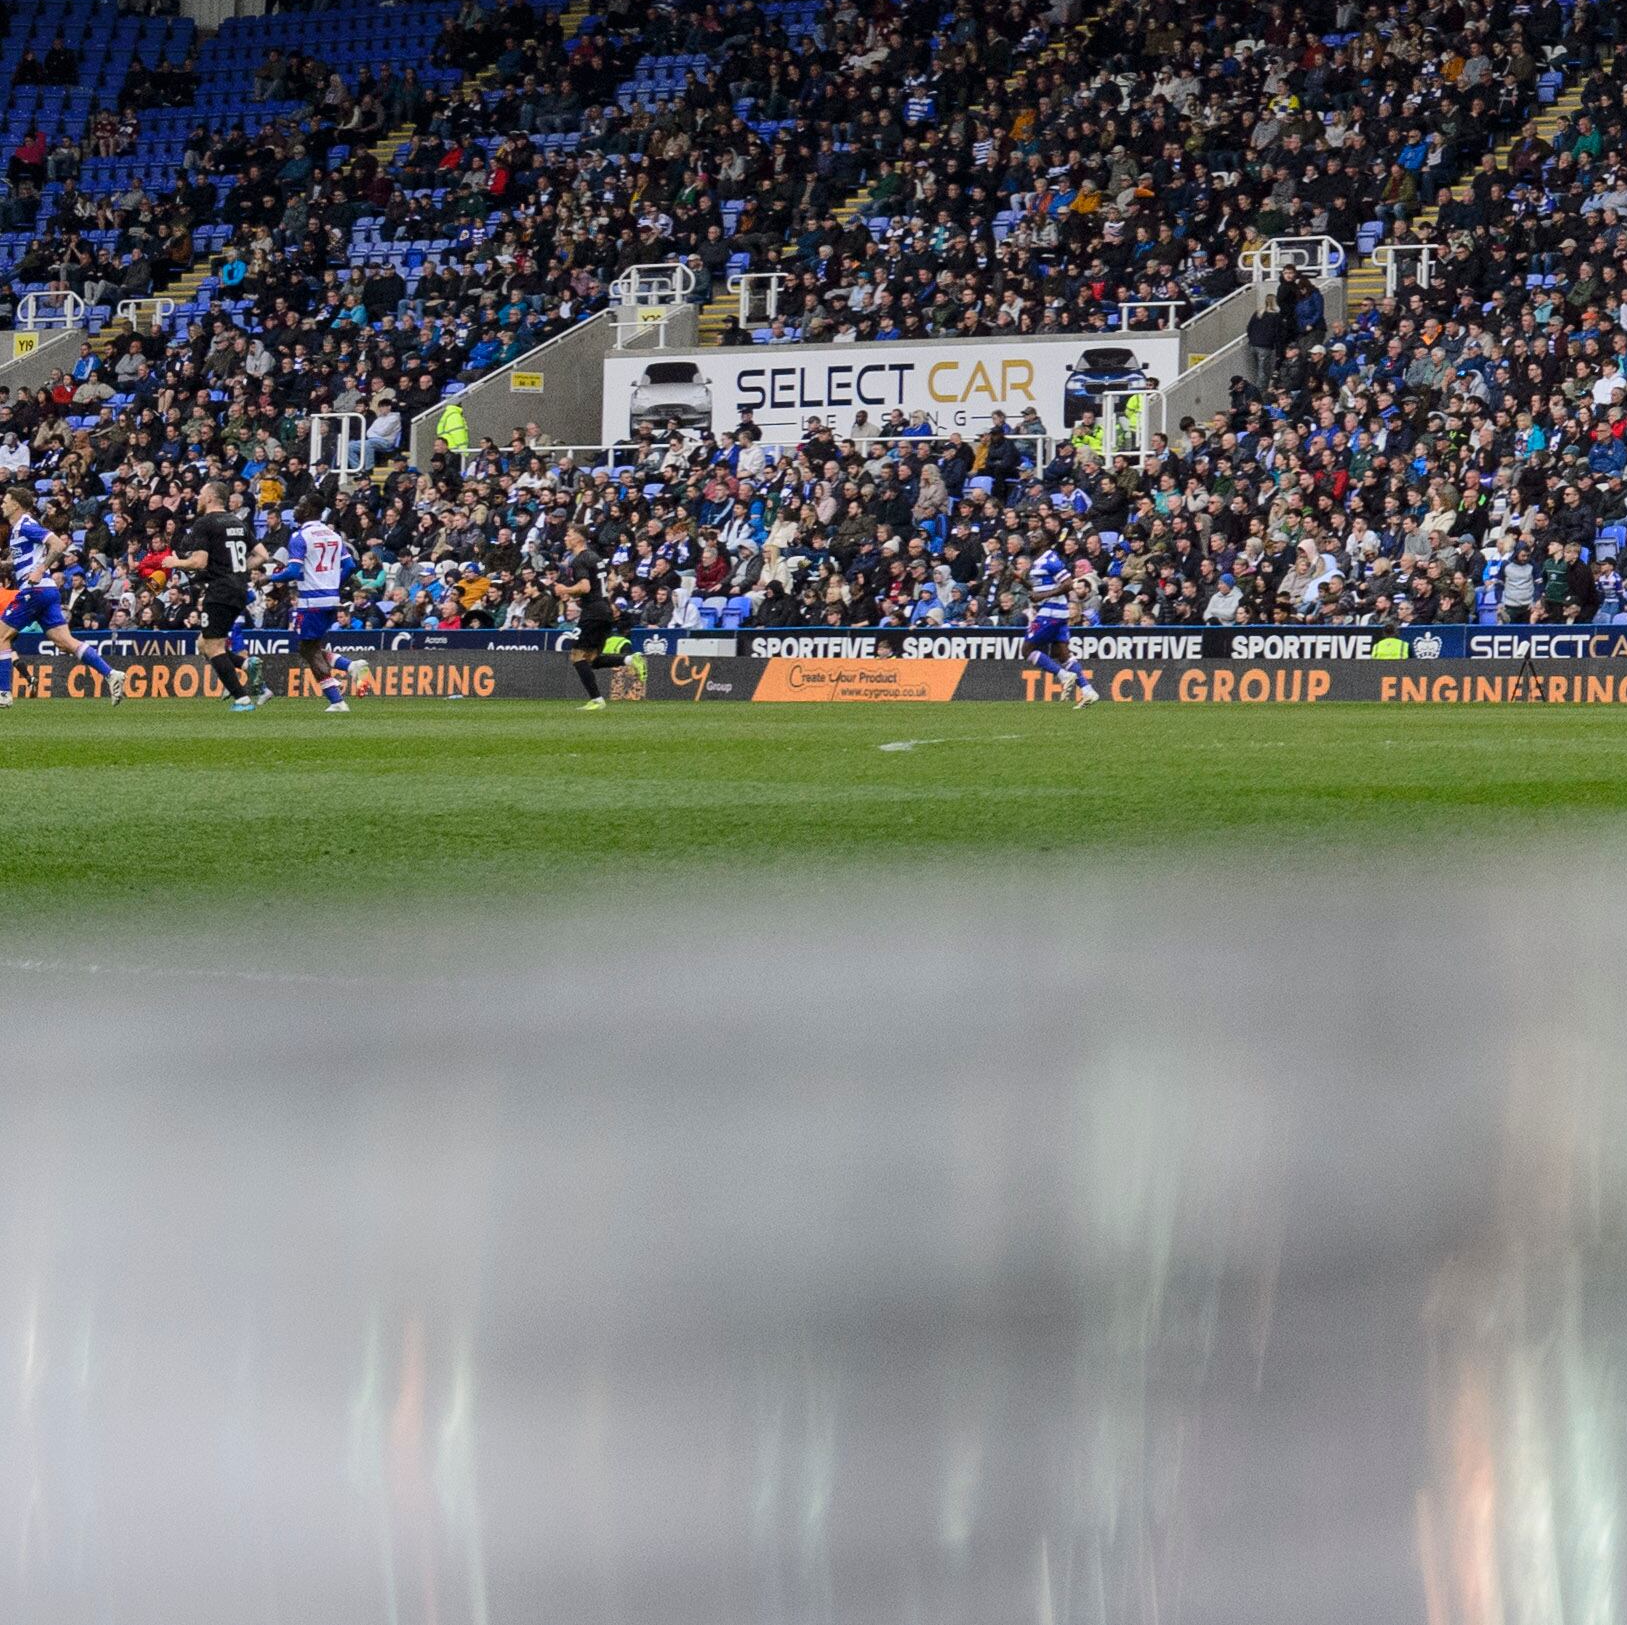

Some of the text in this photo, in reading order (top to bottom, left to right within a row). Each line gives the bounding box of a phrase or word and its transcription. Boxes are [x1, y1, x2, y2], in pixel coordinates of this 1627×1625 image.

[18, 340, 34, 352] Y19
[736, 359, 1037, 410] SELECT CAR
[225, 540, 247, 573] 18
[313, 541, 339, 572] 27
[751, 637, 876, 659] SPORTFIVE
[1068, 636, 1203, 660] SPORTFIVE
[1230, 635, 1374, 660] SPORTFIVE
[706, 680, 733, 694] Group
[859, 672, 897, 684] Product
[1110, 668, 1162, 702] CY
[1178, 668, 1332, 703] GROUP
